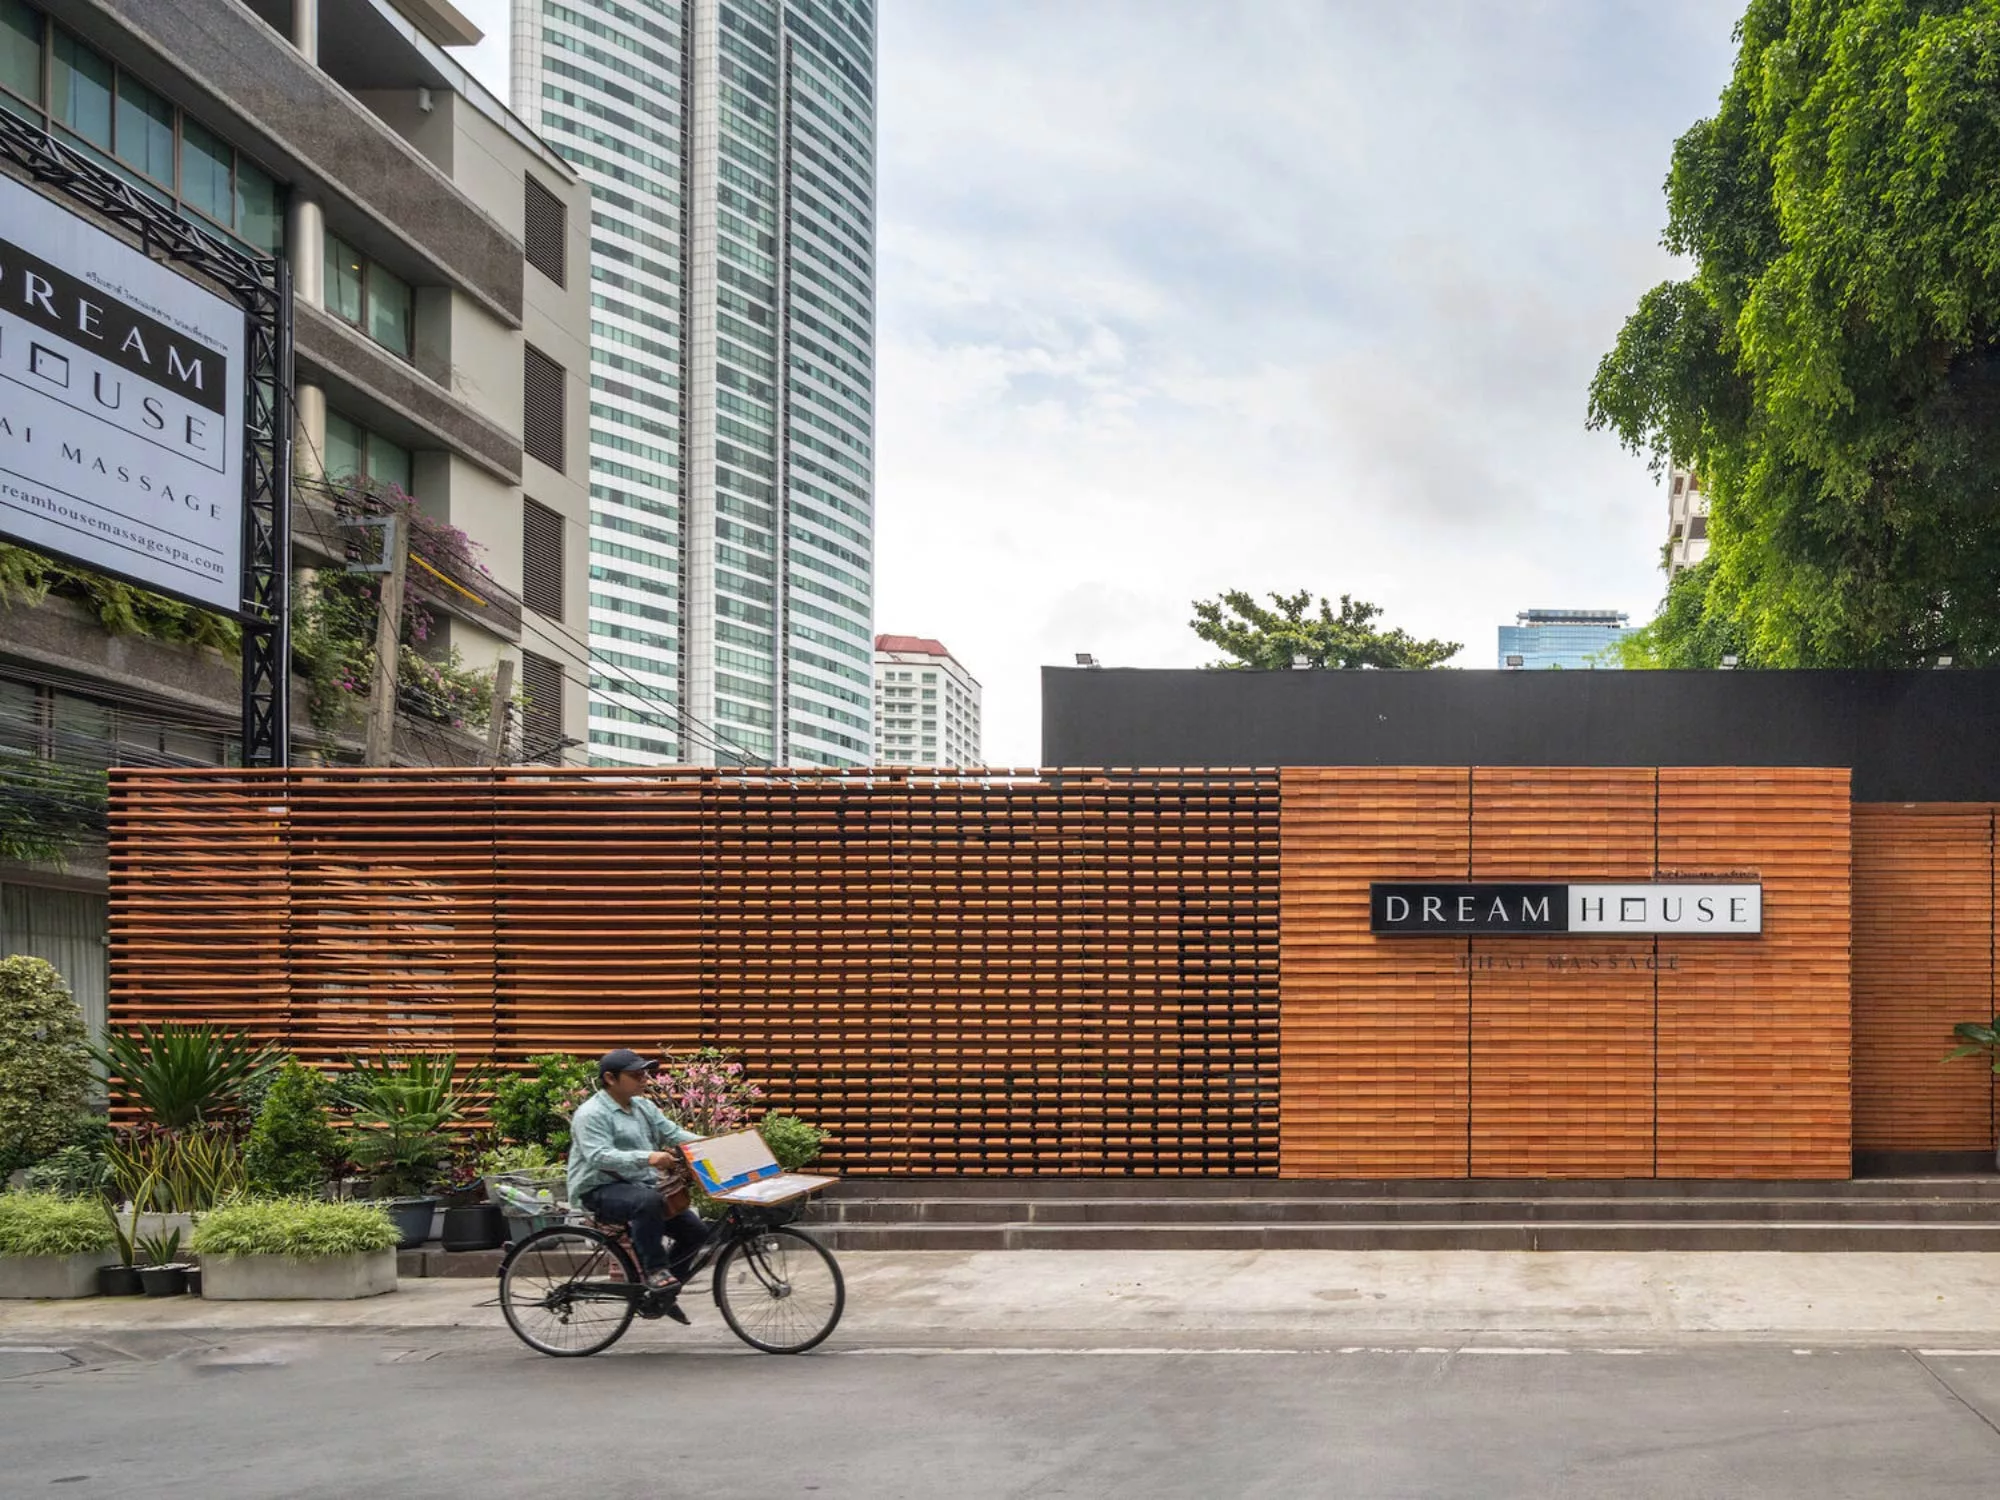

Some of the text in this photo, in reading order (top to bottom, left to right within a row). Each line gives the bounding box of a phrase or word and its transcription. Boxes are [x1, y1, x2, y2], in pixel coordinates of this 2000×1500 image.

[0, 264, 204, 391] REAM
[0, 326, 206, 450] OUSE
[61, 442, 222, 521] MASSAGE
[2, 483, 225, 575] reamhousemassagespa.com
[1386, 895, 1748, 923] DREAM HOUSE
